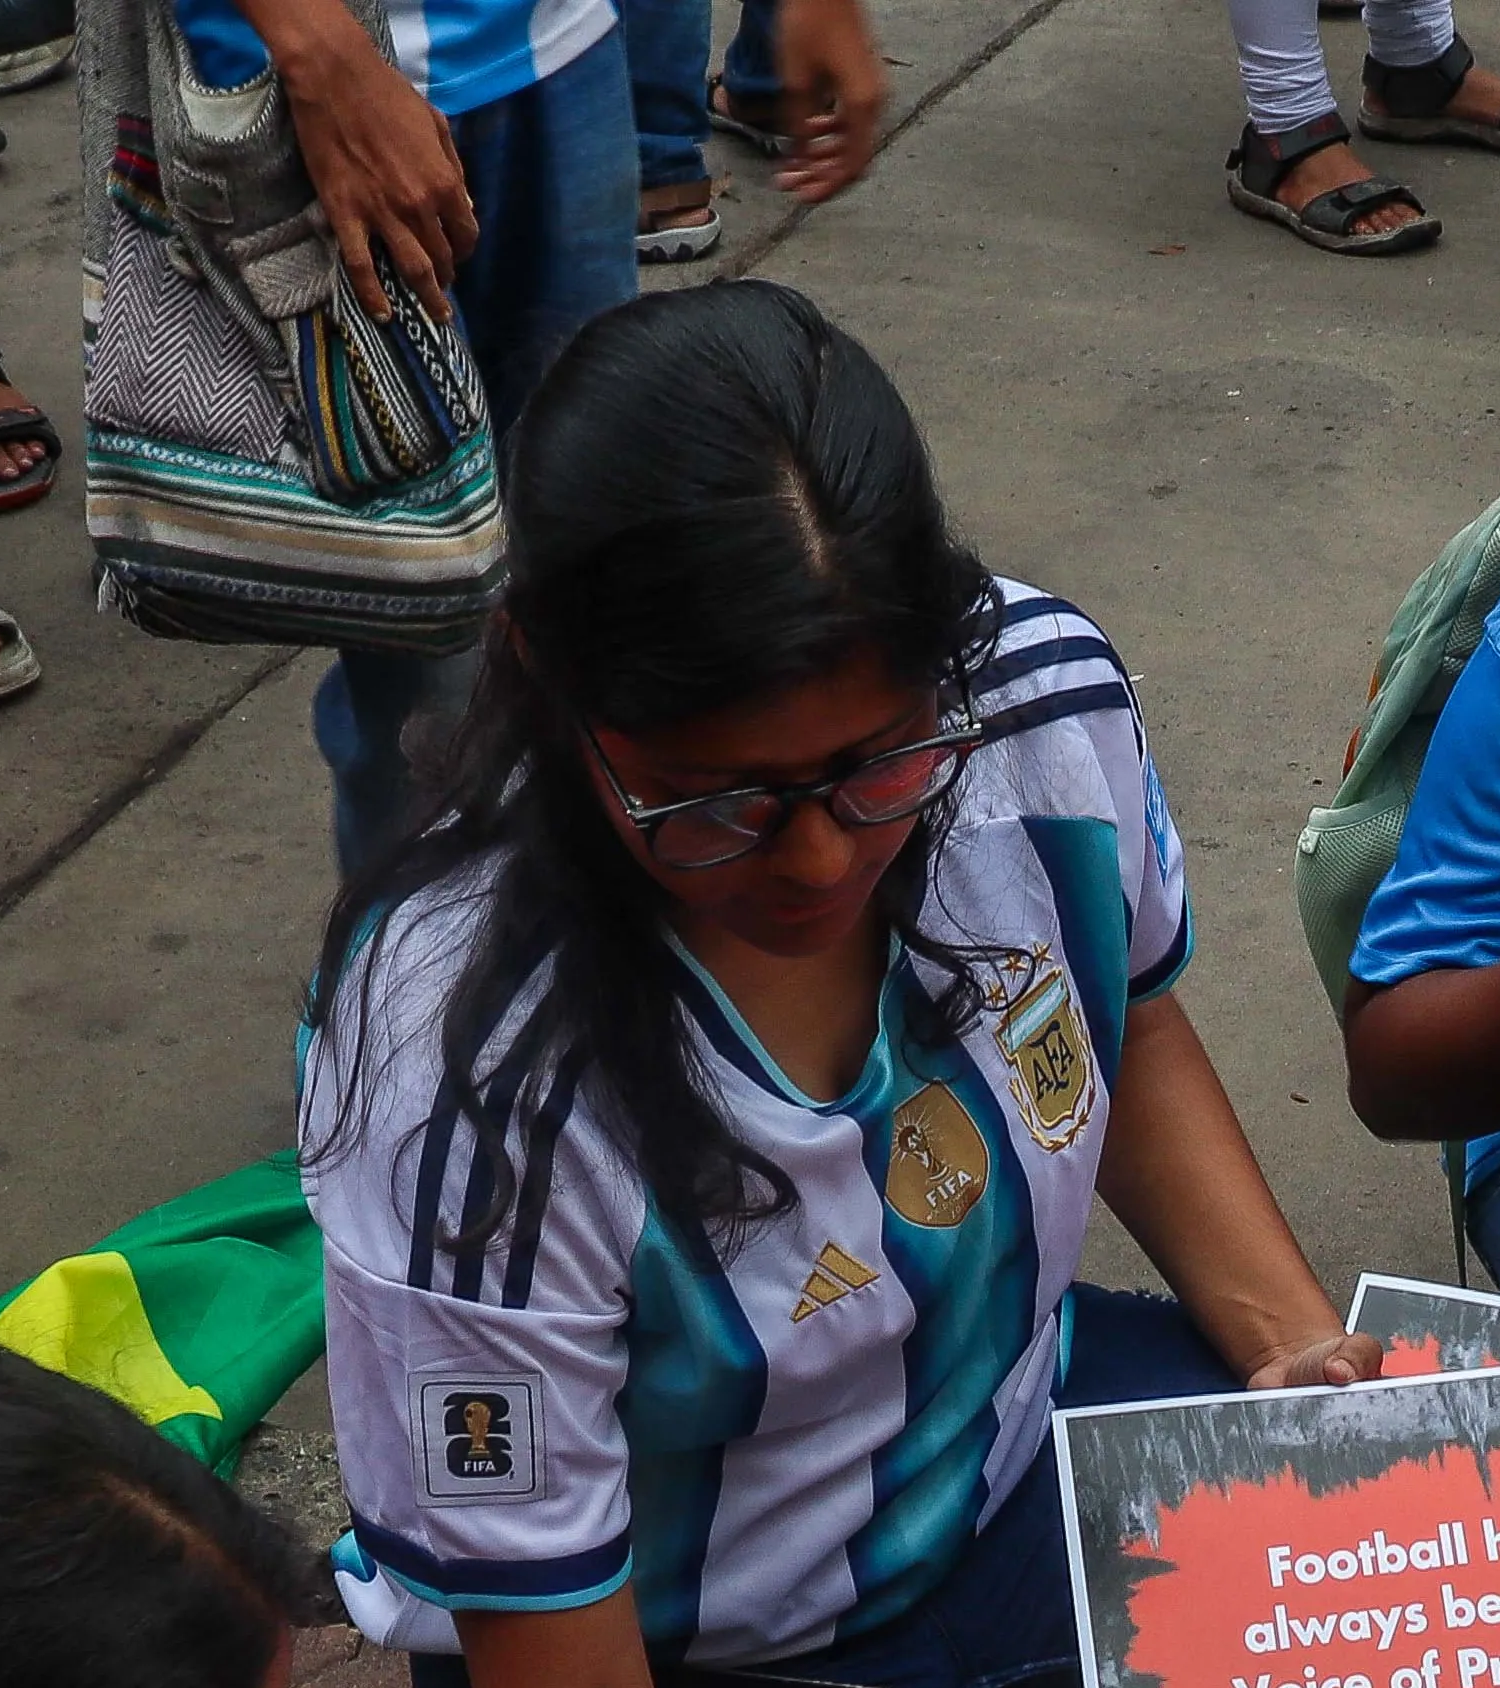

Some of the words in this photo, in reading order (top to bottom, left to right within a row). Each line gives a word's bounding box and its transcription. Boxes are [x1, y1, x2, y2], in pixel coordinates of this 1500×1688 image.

[925, 1169, 973, 1207] FIFA
[464, 1461, 496, 1472] FIFA
[1267, 1521, 1469, 1587] Football
[1244, 1602, 1427, 1654] always
